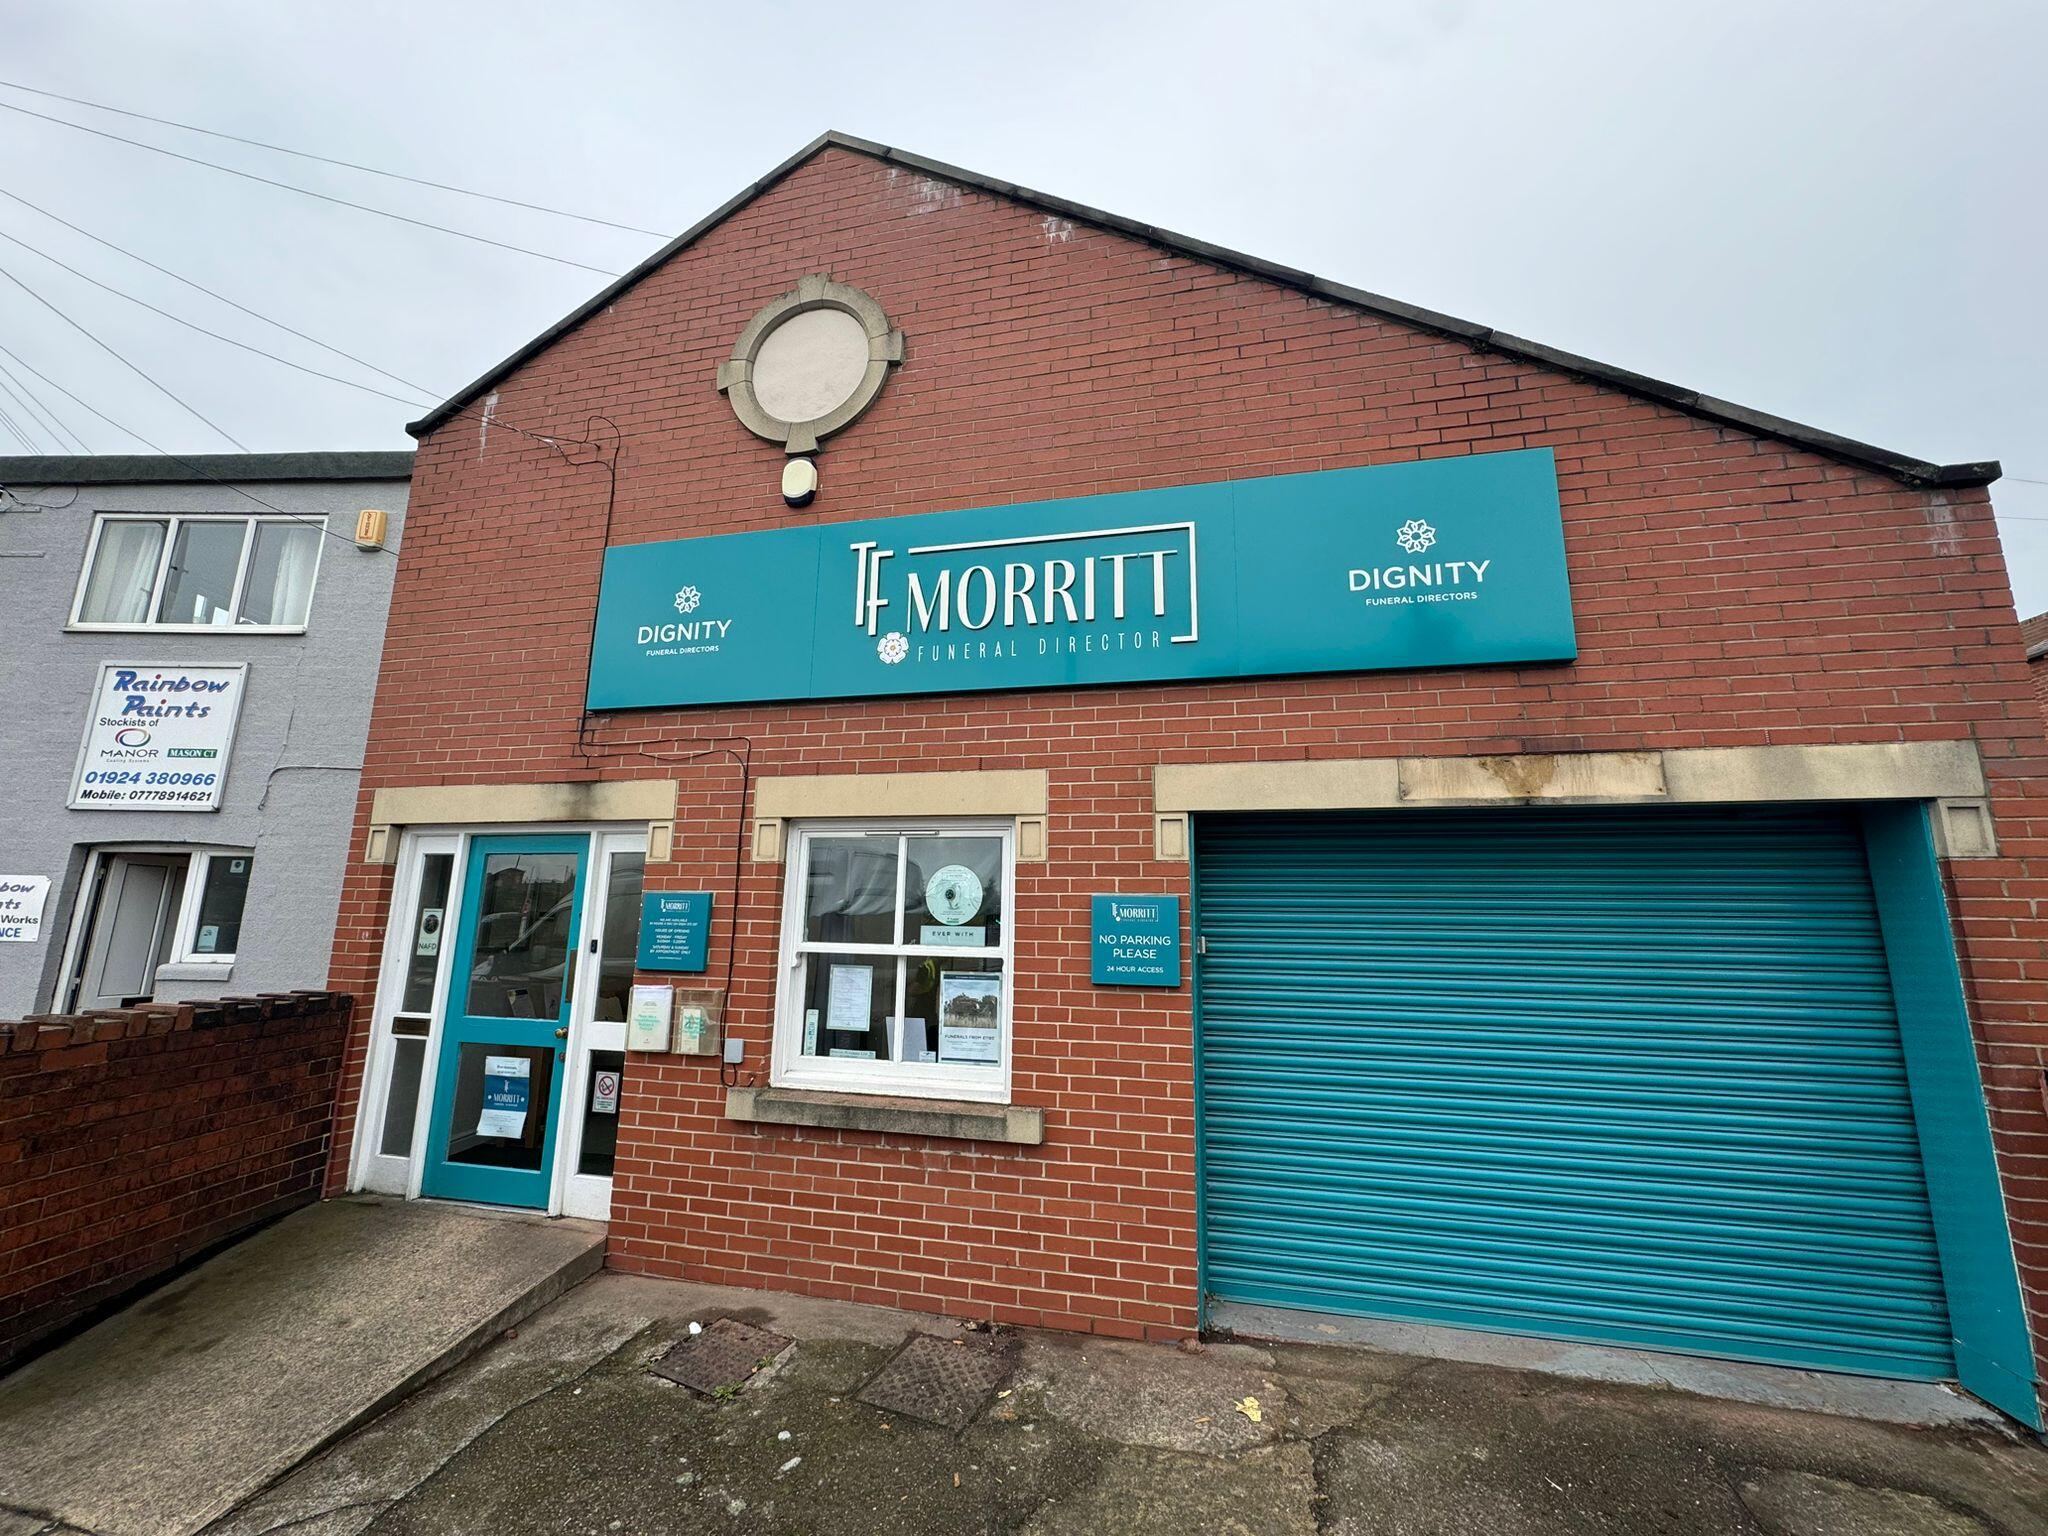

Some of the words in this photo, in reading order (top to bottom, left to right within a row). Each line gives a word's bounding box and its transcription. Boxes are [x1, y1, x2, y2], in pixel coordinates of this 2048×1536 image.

[1349, 559, 1491, 592] DIGNITY
[906, 549, 1178, 634] MORRITT
[1365, 596, 1415, 606] FUNERAL
[1417, 592, 1478, 604] DIRECTORS
[637, 619, 732, 645] DIGNITY
[646, 646, 677, 656] FUNERAL
[678, 645, 720, 655] DIRECTORS
[917, 634, 1018, 663] FUNERAL
[1039, 631, 1160, 656] DIRECTOR
[113, 670, 230, 693] Rainbow
[121, 695, 211, 718] Paints
[99, 717, 146, 727] Stockists
[148, 718, 160, 727] of
[100, 749, 159, 758] MANOR
[169, 748, 202, 758] MASON
[203, 749, 216, 758] CT
[85, 771, 142, 785] 01924
[145, 772, 216, 786] 380966
[80, 789, 126, 800] Mobile:
[129, 790, 212, 801] 07778914621
[1120, 908, 1155, 919] MORRITT
[1, 915, 39, 924] Works
[1099, 935, 1117, 944] NO
[1120, 935, 1171, 946] PARKING
[1113, 948, 1157, 959] PLEASE
[493, 1093, 520, 1103] MORRITT
